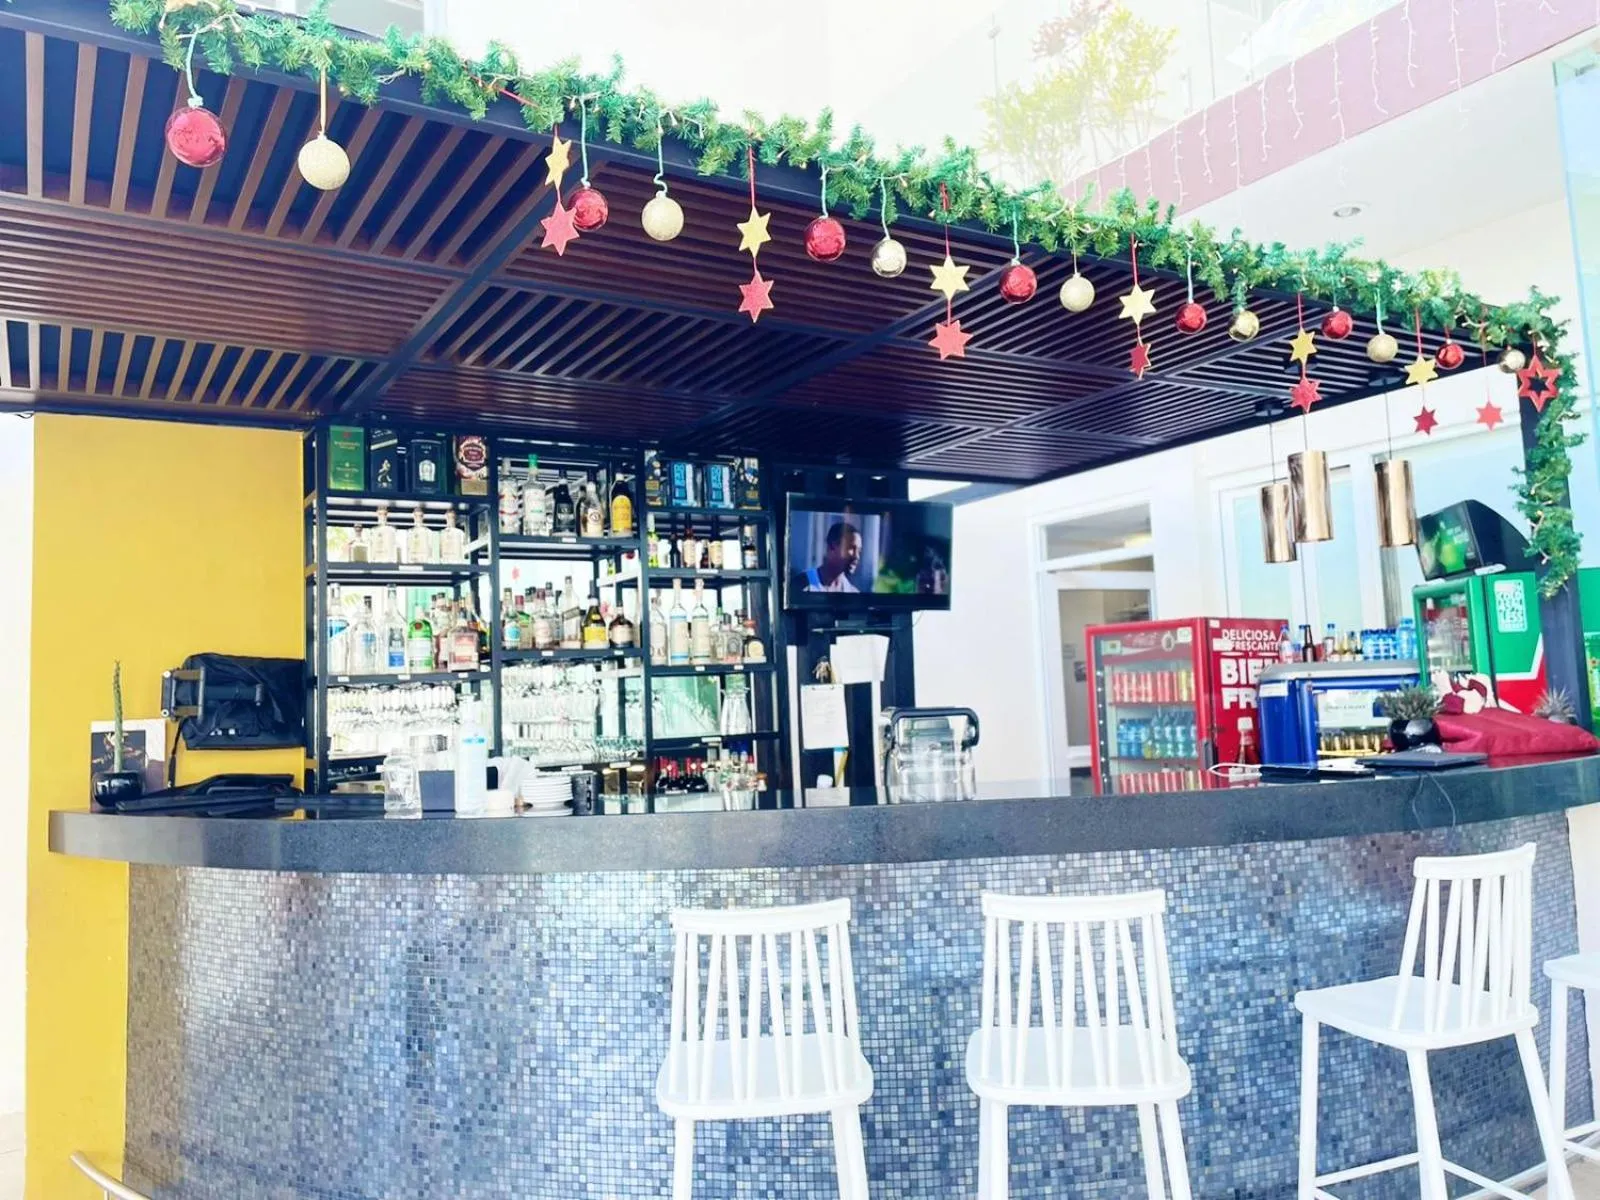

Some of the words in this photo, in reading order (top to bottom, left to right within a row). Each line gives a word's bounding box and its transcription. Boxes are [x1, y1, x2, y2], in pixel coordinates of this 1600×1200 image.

[1221, 629, 1276, 641] DELICIOSA
[1220, 658, 1278, 685] BIE
[1221, 687, 1258, 709] FR
